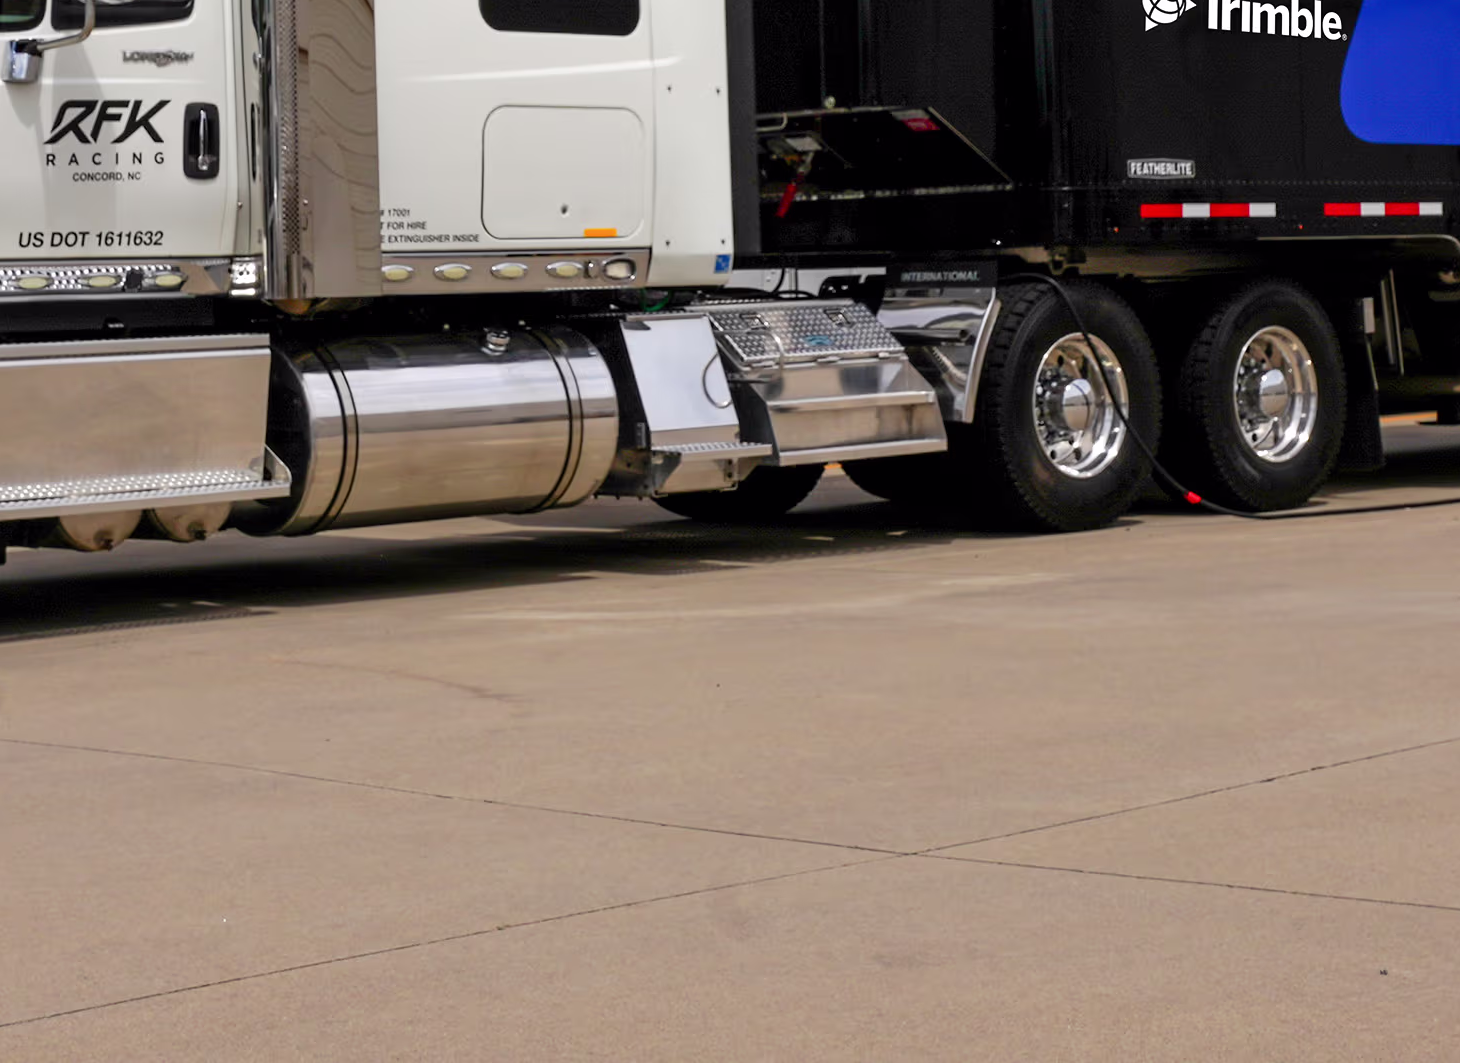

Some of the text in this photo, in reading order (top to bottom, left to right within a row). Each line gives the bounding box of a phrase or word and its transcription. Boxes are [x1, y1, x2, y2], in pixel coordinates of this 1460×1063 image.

[43, 100, 171, 144] RFK
[46, 152, 165, 166] RACING
[1130, 162, 1193, 176] FEATHERLITE
[72, 171, 141, 182] CONCORD, NC
[387, 221, 405, 230] FOR
[406, 221, 427, 230] HIRE
[18, 230, 164, 248] US DOT 1611632
[388, 234, 451, 244] EXTINGUISHER
[452, 234, 480, 243] INSIDE
[901, 271, 980, 283] INTERNATIONAL
